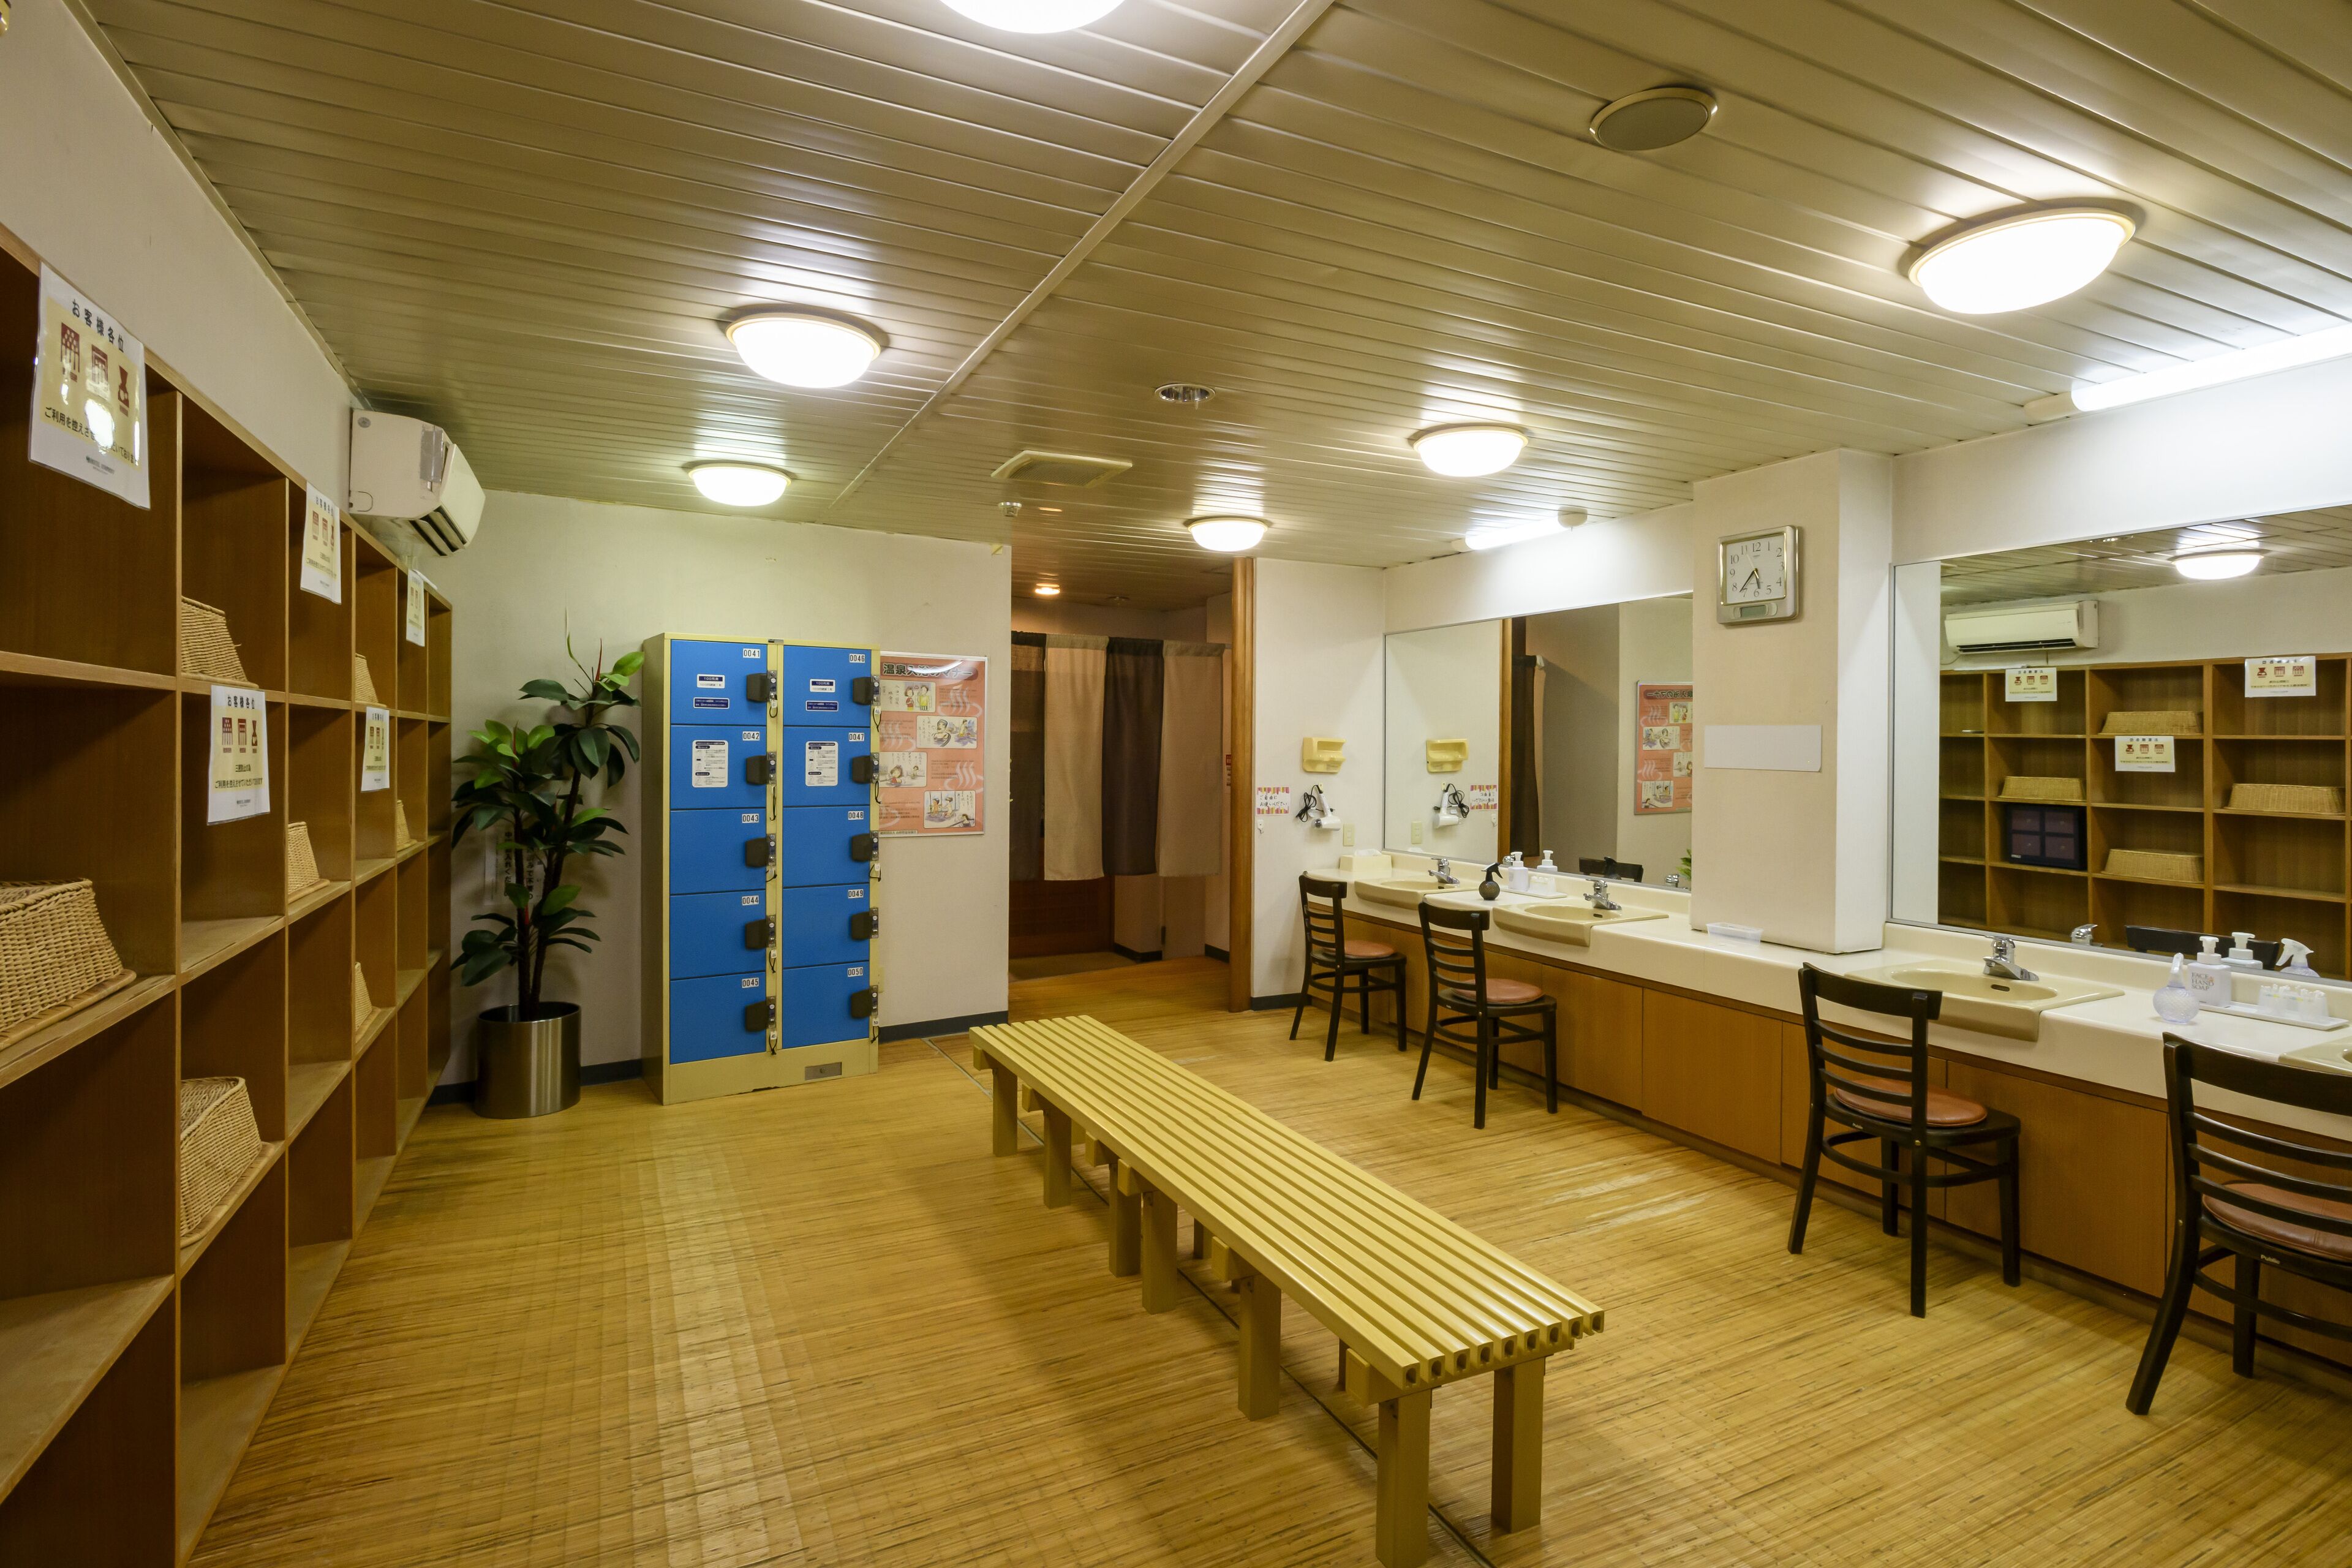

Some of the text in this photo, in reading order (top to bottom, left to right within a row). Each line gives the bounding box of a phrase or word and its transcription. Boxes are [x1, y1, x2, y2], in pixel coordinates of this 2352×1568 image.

[72, 298, 124, 353] お客様各位
[1741, 545, 1747, 555] 11
[1752, 541, 1761, 552] 12
[1776, 547, 1782, 557] 2
[1730, 554, 1739, 564] 10
[1779, 561, 1784, 571] 3
[1729, 568, 1735, 578] 9
[1776, 576, 1782, 586] 4
[1732, 582, 1738, 592] 8
[1765, 585, 1771, 595] 5
[1742, 587, 1747, 598] 7
[1754, 588, 1759, 598] 6
[227, 695, 255, 709] お客様各位
[742, 896, 759, 905] 0044
